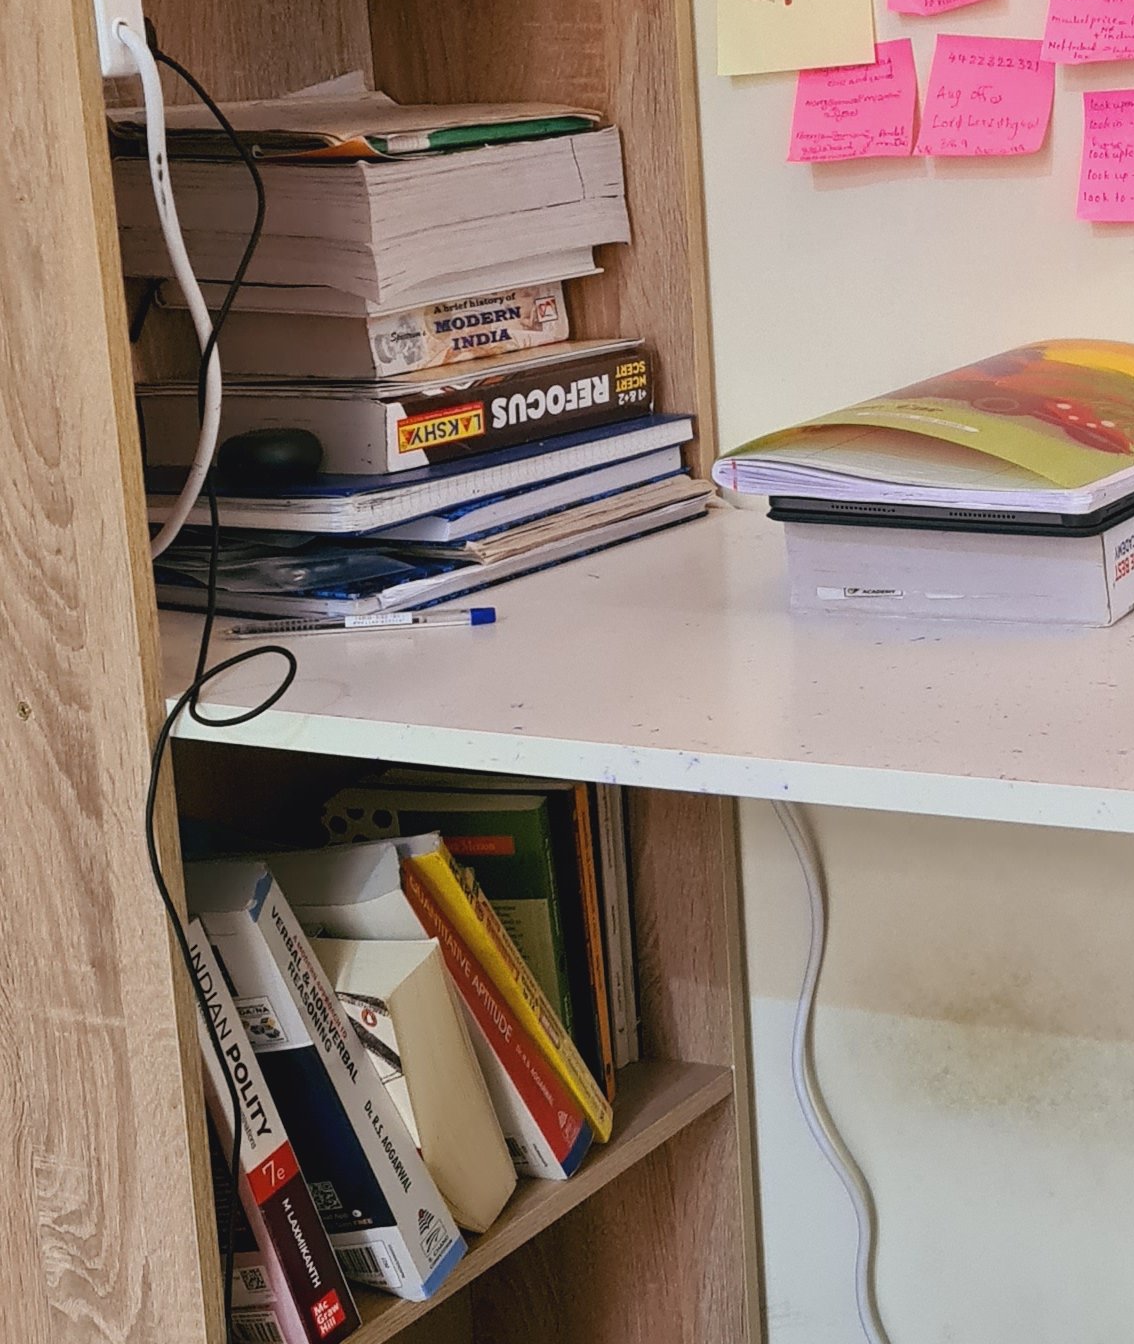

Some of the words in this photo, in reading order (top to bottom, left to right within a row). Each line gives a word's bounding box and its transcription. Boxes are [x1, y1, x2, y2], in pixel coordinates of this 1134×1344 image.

[433, 305, 442, 315] A
[443, 300, 463, 314] brief
[463, 295, 503, 312] history
[505, 292, 516, 303] of
[434, 306, 522, 334] MODERN
[452, 328, 513, 352] INDIA
[615, 361, 647, 378] SCERT
[615, 374, 647, 393] NCERT
[491, 373, 610, 429] REFOCUS
[409, 874, 471, 977] QUANTITATIVE
[471, 975, 513, 1044] APTITUDE
[271, 906, 301, 969] VERBAL
[302, 972, 311, 987] &
[309, 986, 360, 1085] NON-VERBAL
[287, 962, 333, 1054] REASONING
[190, 944, 232, 1041] INDIAN
[226, 1043, 272, 1137] POLITY
[364, 1099, 373, 1116] Dr.
[371, 1116, 382, 1138] R.S.
[381, 1136, 413, 1194] AGGARWAL
[262, 1162, 286, 1187] 7e
[281, 1197, 290, 1209] M
[287, 1209, 322, 1289] LAXMIKANTH
[313, 1300, 329, 1315] Mc
[316, 1303, 341, 1324] Graw
[319, 1318, 336, 1337] Hill
